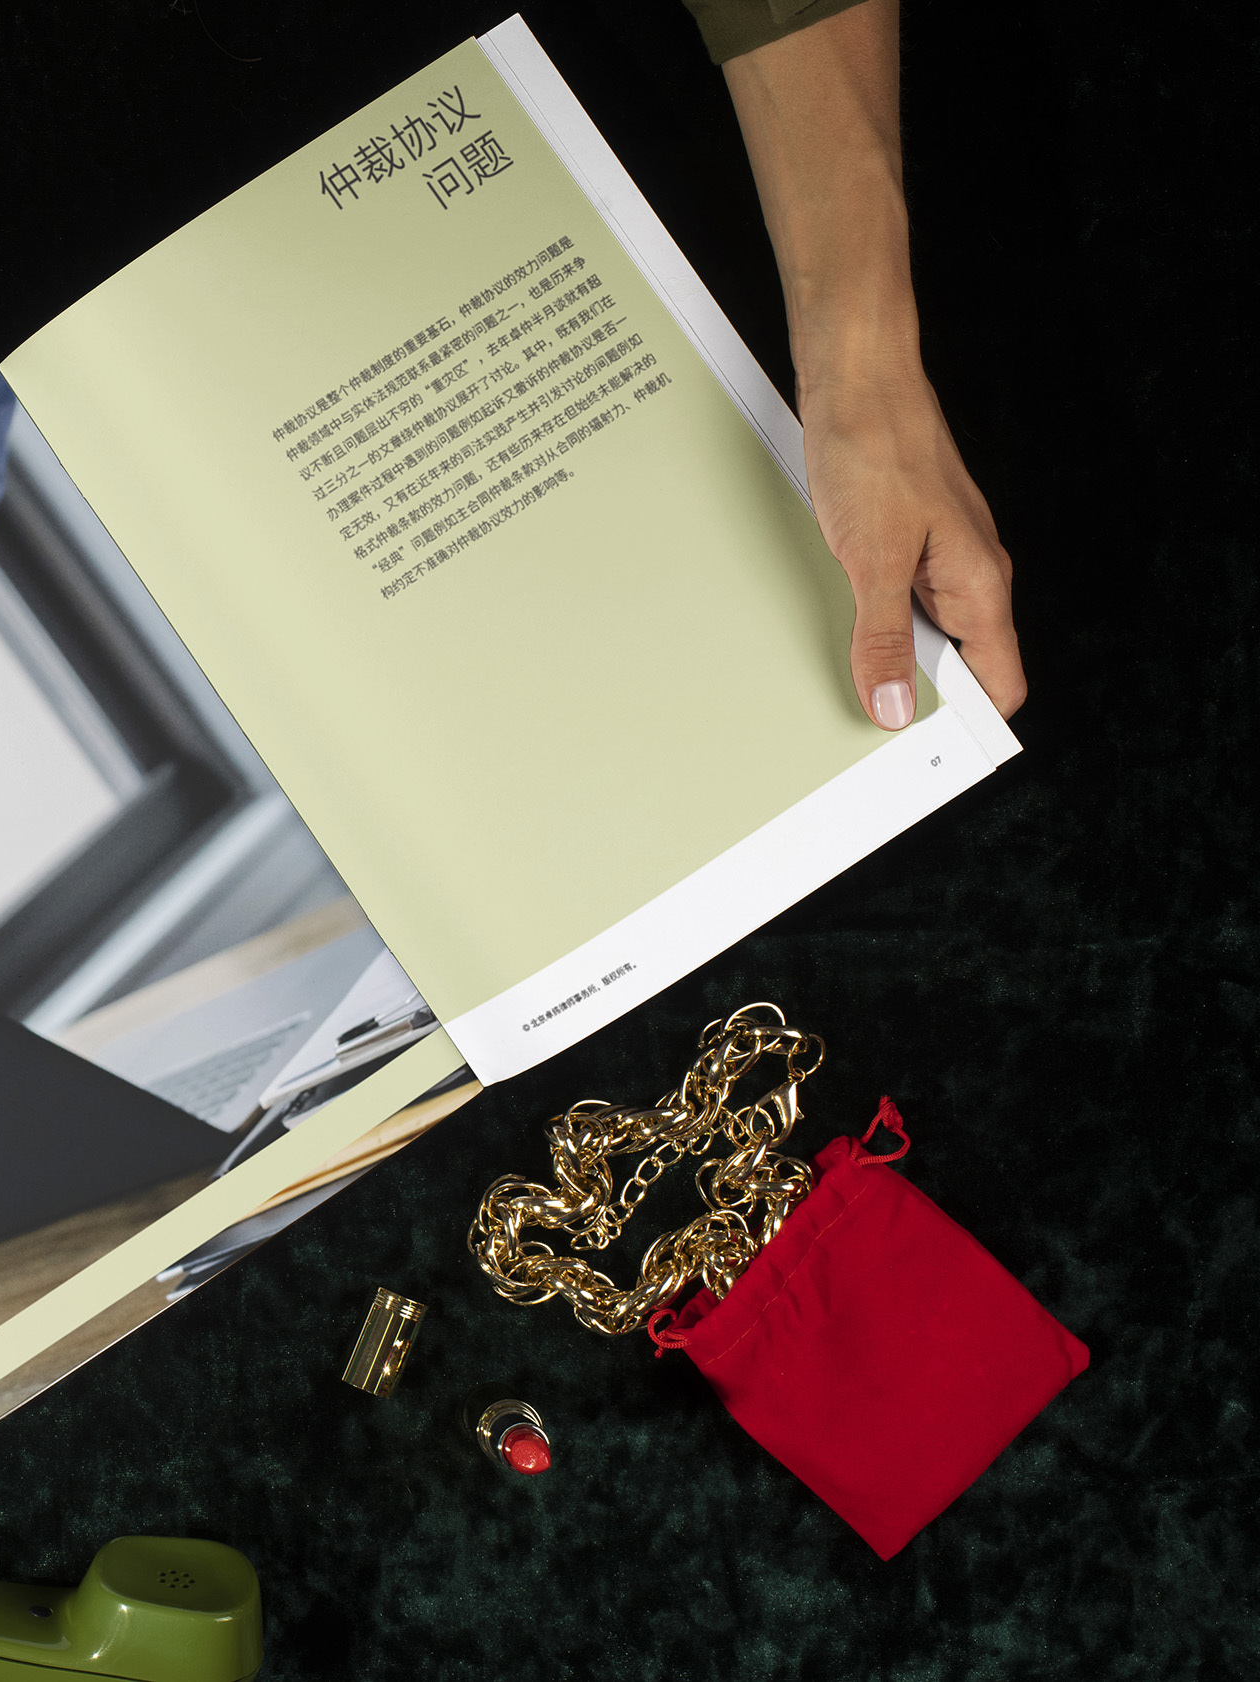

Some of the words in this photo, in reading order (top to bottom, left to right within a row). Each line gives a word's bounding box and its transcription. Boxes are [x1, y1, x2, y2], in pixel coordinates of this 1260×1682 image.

[319, 85, 481, 210] 仲裁协议
[422, 130, 514, 210] 问题
[272, 235, 574, 442] 仲裁协议是整个仲裁制度的重要基石，仲裁协议的效力问题是
[285, 256, 585, 462] 仲裁领域中与实体法规范联系最紧密的问题之一，也是历来争
[311, 294, 616, 501] 过三分之一的文章绕仲裁协议展开了讨论。其中，既有我们在
[353, 353, 656, 560] 格式仲裁条款的效力问题，还有些历来存在但始终未能解决的
[380, 467, 574, 599] 构约定不准确对仲裁协议效力的影响等。
[930, 755, 942, 767] 07
